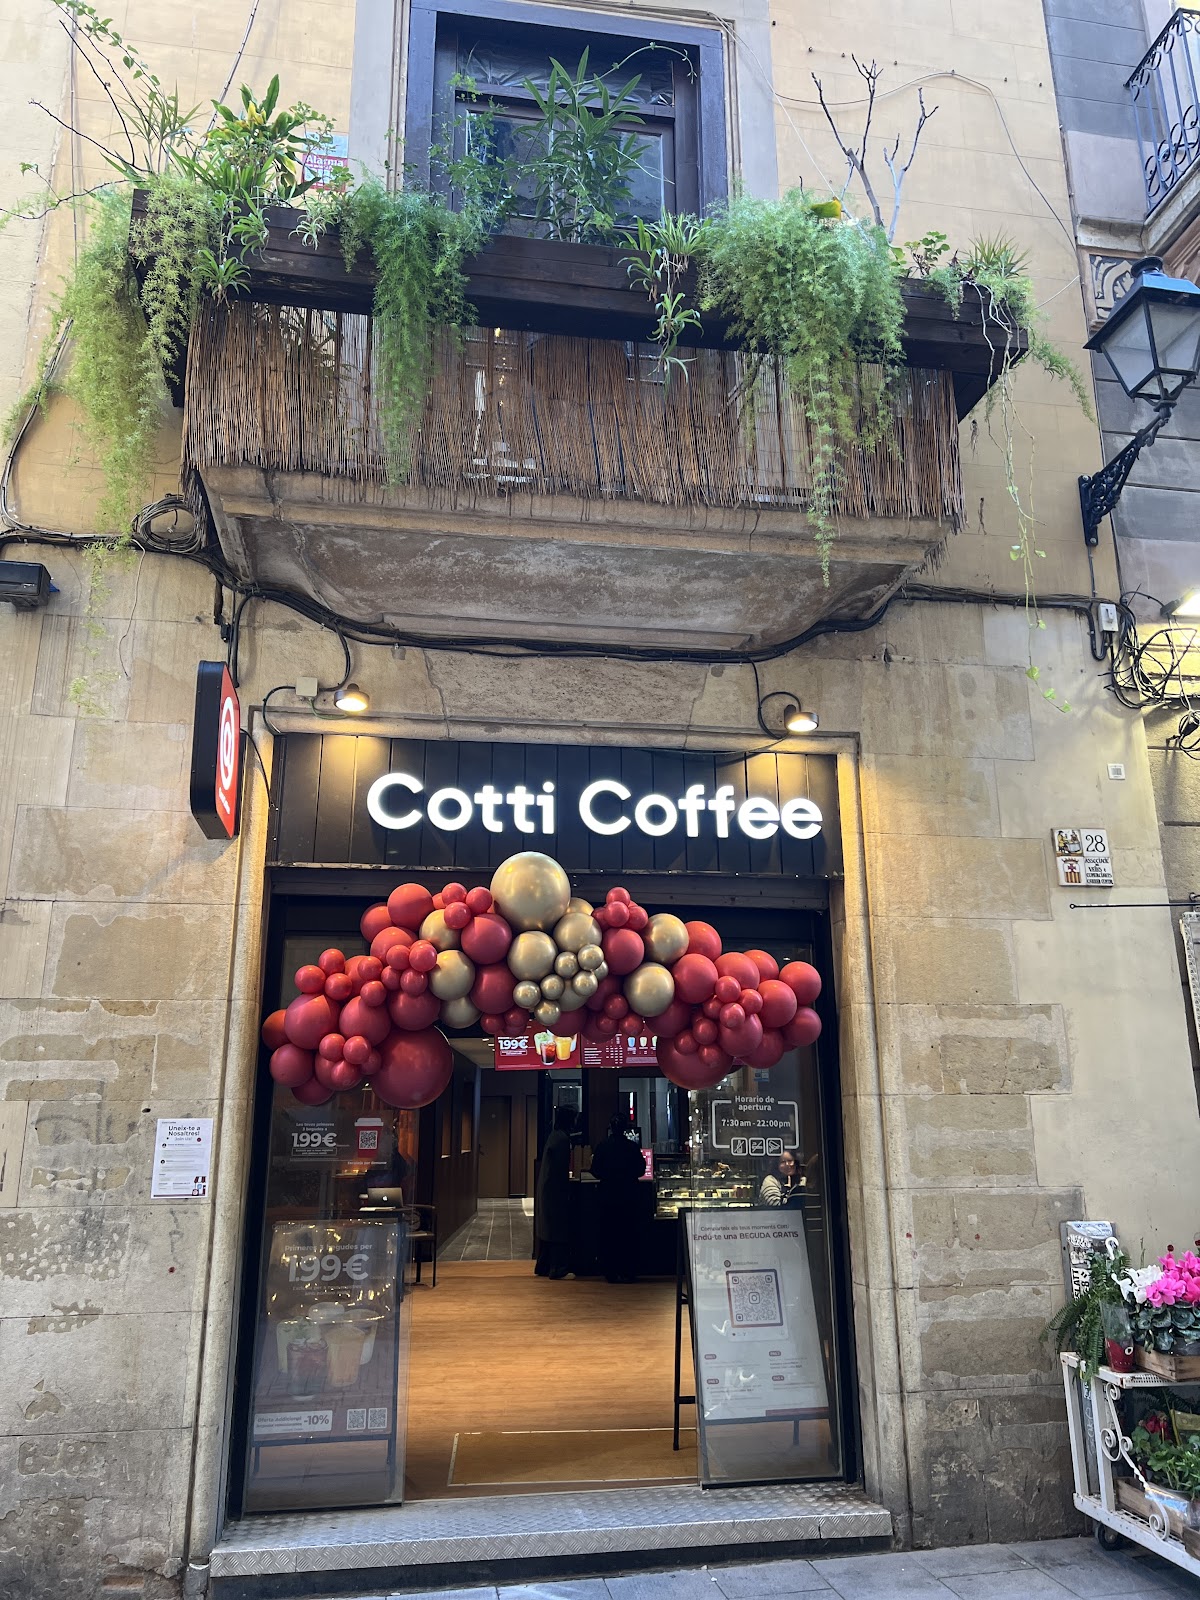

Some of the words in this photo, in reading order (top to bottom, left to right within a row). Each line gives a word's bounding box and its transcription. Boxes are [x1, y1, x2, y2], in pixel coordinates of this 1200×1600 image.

[306, 155, 344, 167] Alarma
[367, 772, 555, 835] Cotti
[579, 779, 823, 840] Coffee
[1085, 834, 1106, 853] 28
[735, 1095, 764, 1103] Horario
[765, 1095, 775, 1103] de
[738, 1104, 772, 1112] apertura
[739, 1232, 771, 1240] BEGUDA
[772, 1231, 799, 1239] GRATIS
[284, 1244, 318, 1252] Primeres
[359, 1244, 373, 1252] per
[288, 1253, 370, 1283] 1.99€
[304, 1414, 329, 1426] -10%
